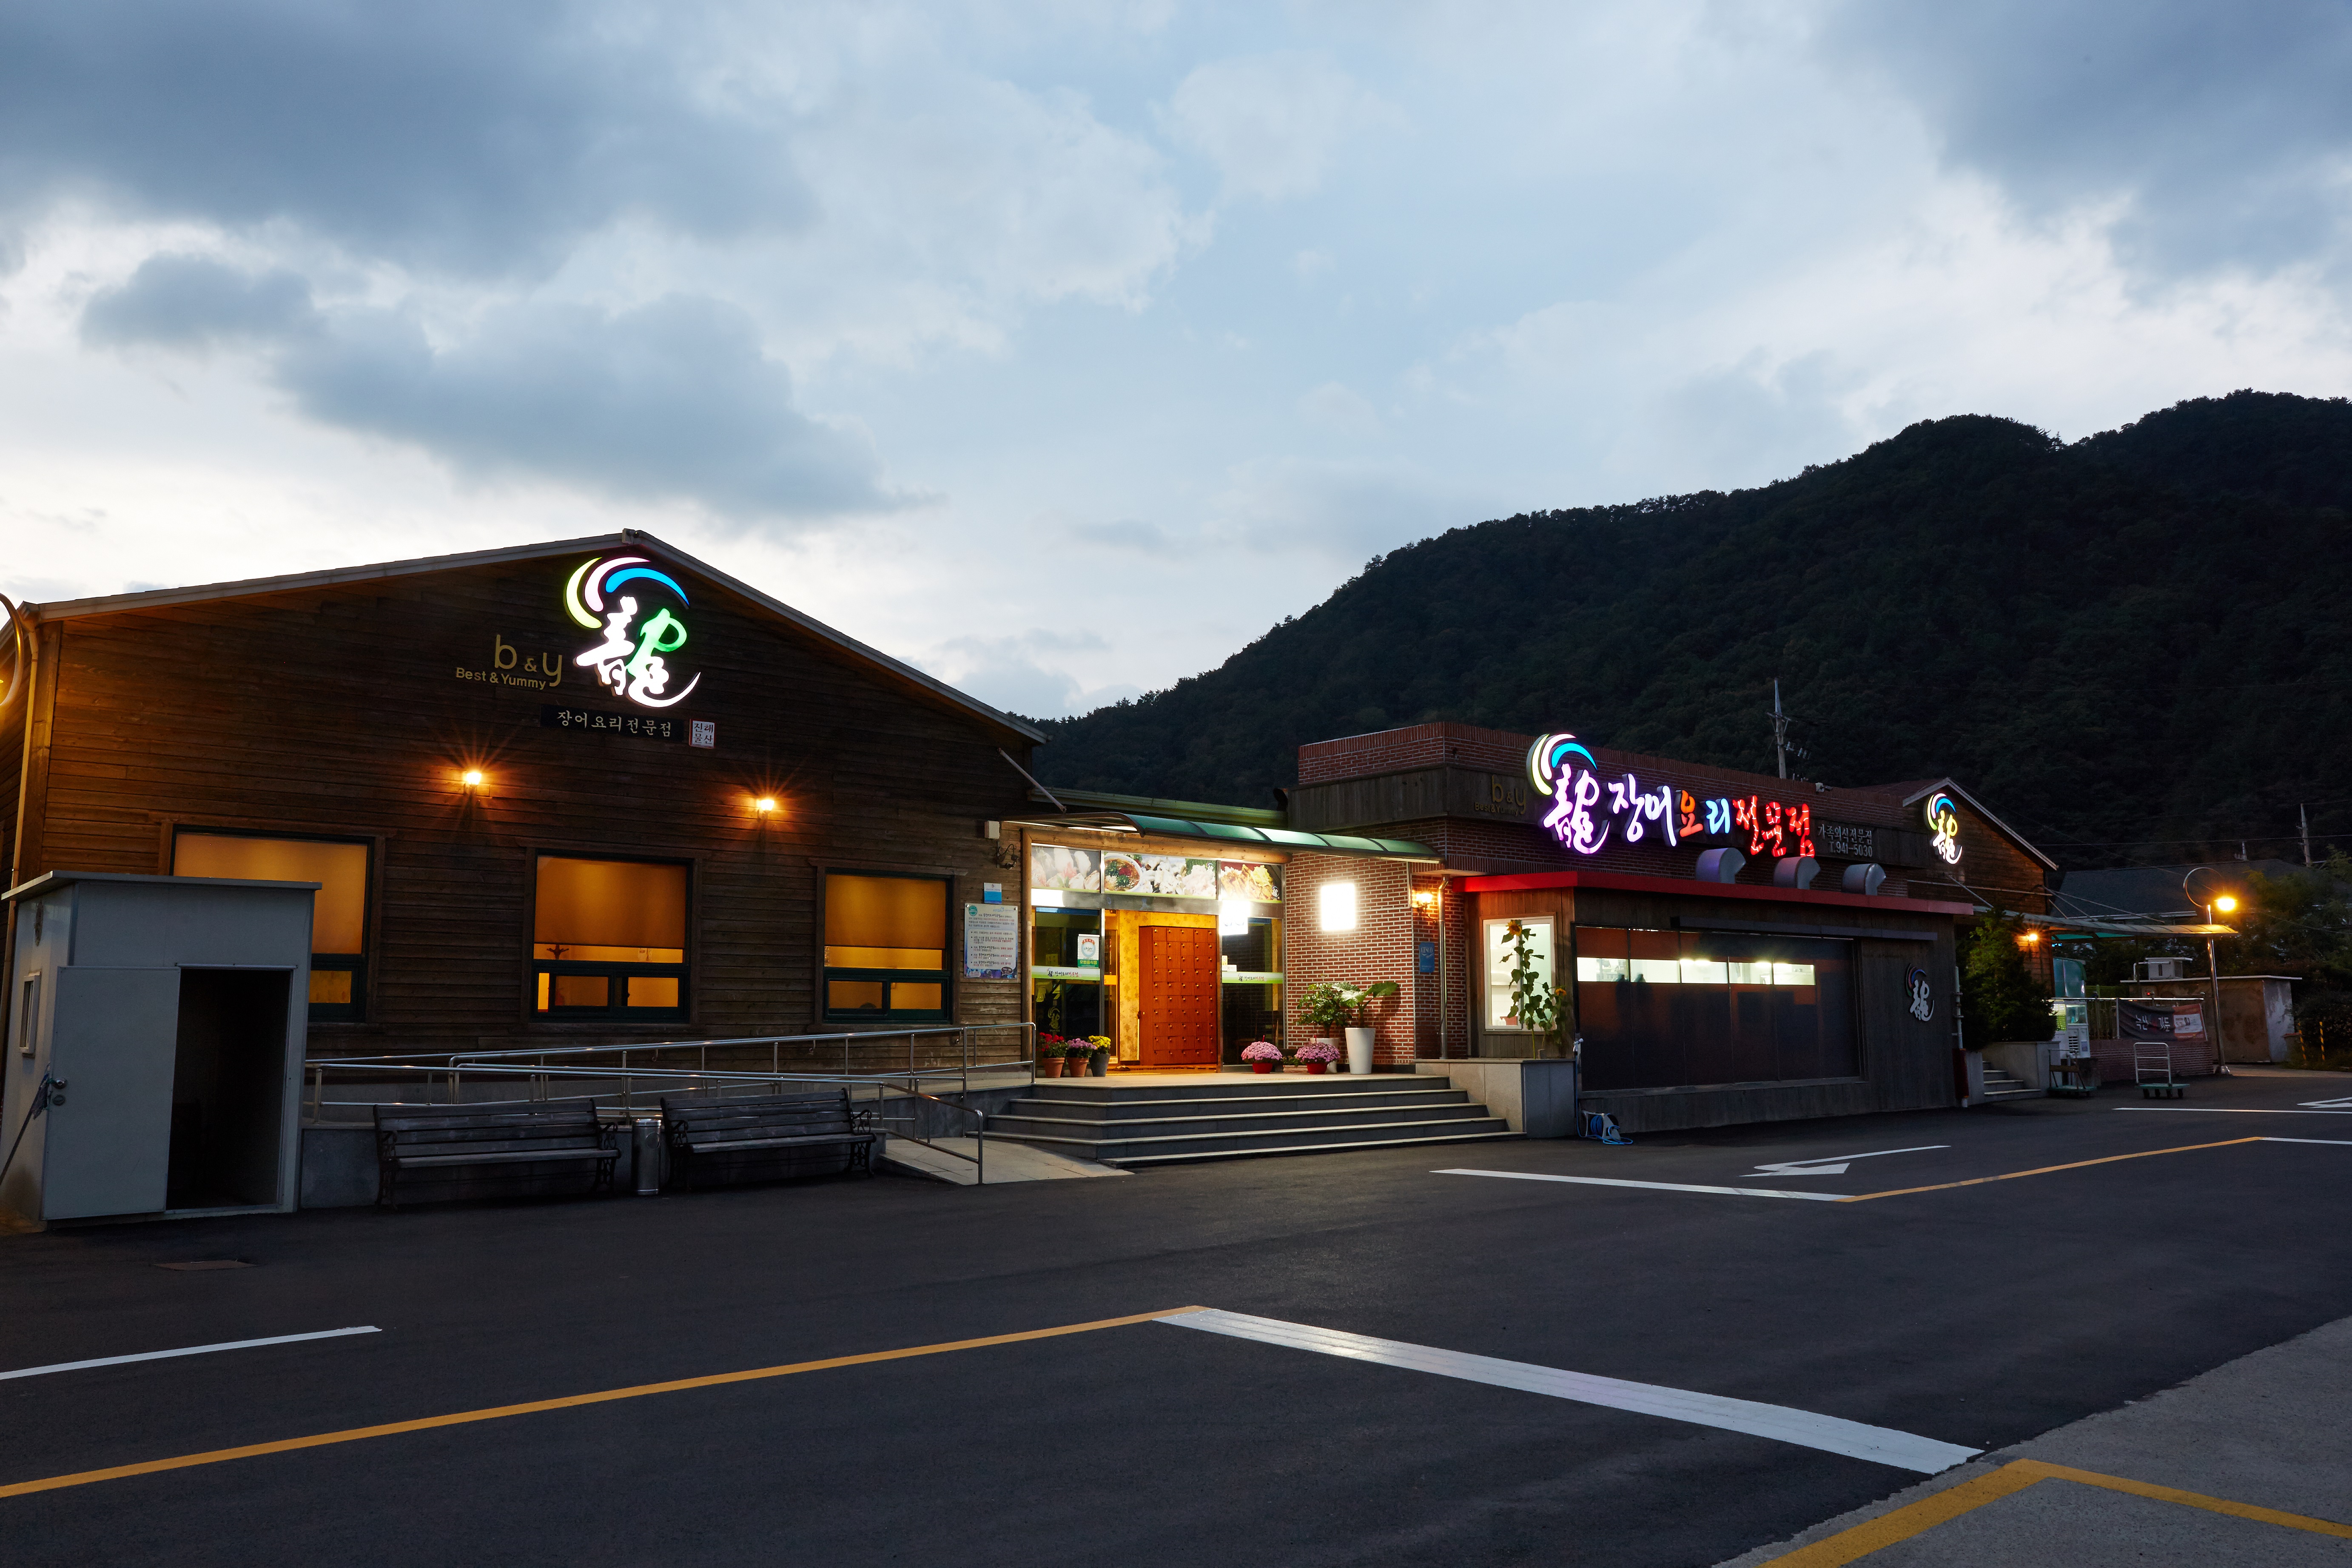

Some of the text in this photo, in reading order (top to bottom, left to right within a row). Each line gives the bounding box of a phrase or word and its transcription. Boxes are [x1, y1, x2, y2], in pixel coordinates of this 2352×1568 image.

[456, 667, 546, 690] Best & Yummy
[557, 710, 671, 737] 장어요리전문점
[694, 723, 713, 734] 진해
[693, 733, 713, 744] 물산
[1818, 824, 1872, 845] 가족외식전문점
[1829, 841, 1873, 857] T.941-5030
